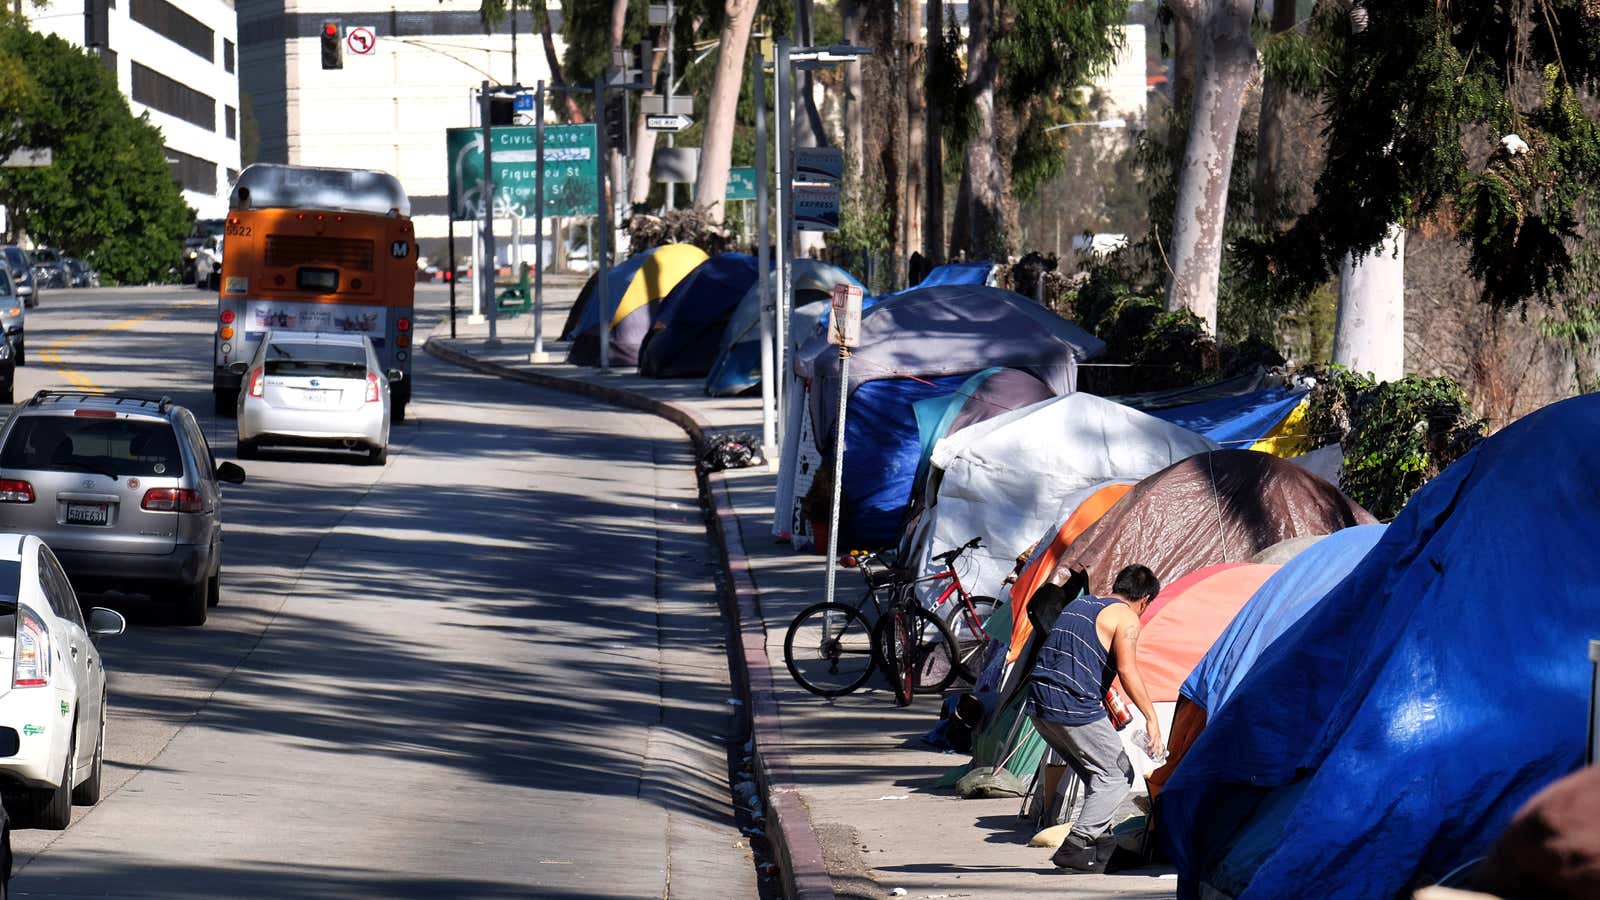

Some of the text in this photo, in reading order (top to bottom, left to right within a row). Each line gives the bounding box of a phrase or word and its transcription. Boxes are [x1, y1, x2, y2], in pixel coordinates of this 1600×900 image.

[501, 134, 533, 145] Civic
[502, 166, 580, 181] Figueoa St
[800, 200, 834, 209] EXPRESS
[392, 243, 407, 257] M
